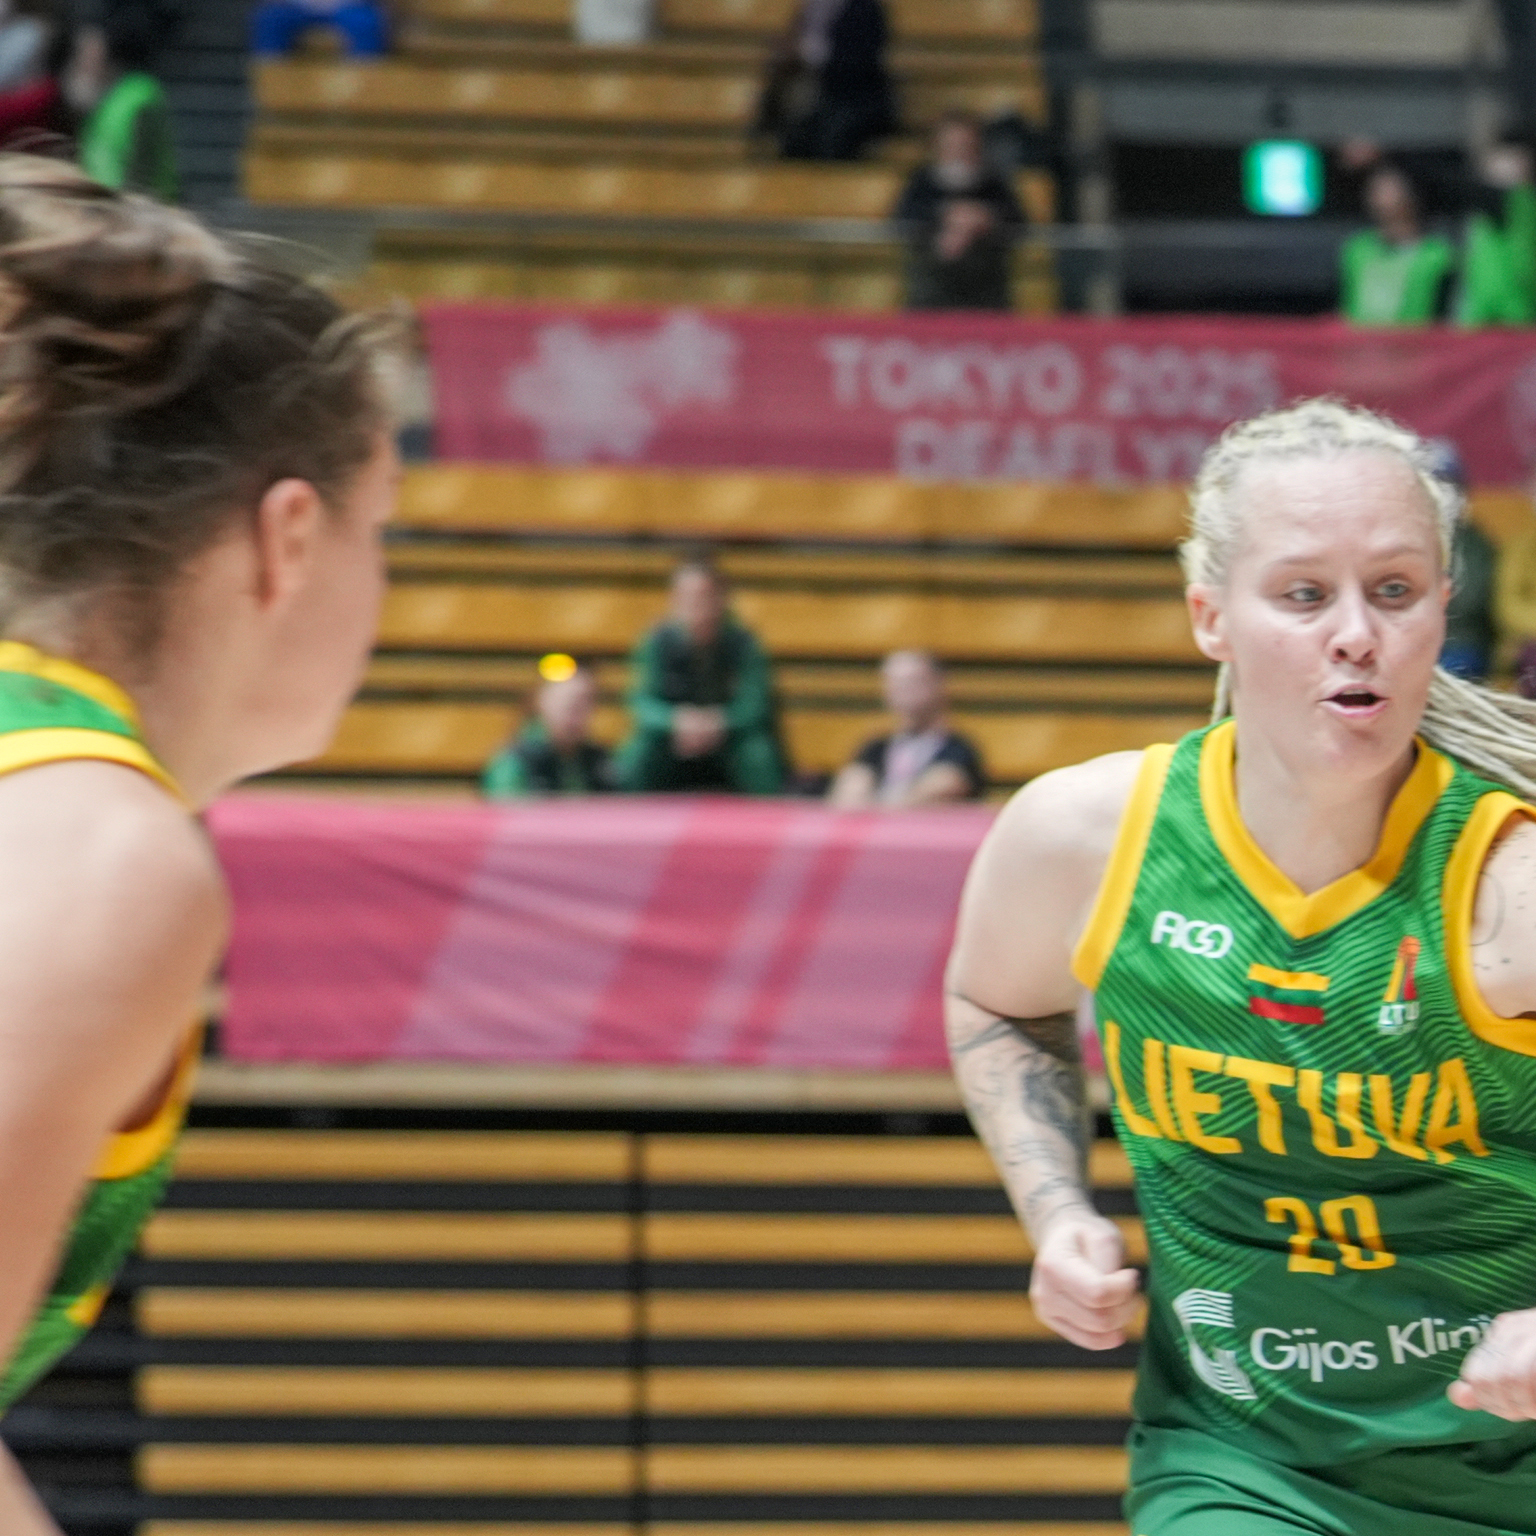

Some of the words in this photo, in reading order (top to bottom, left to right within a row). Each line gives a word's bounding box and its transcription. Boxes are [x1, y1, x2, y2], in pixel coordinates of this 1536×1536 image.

[822, 334, 1082, 416] TOKYO
[1103, 345, 1283, 420] 2025
[1105, 1021, 1491, 1165] LIETUVA
[1264, 1194, 1397, 1276] 20
[1250, 1326, 1379, 1383] Gijos
